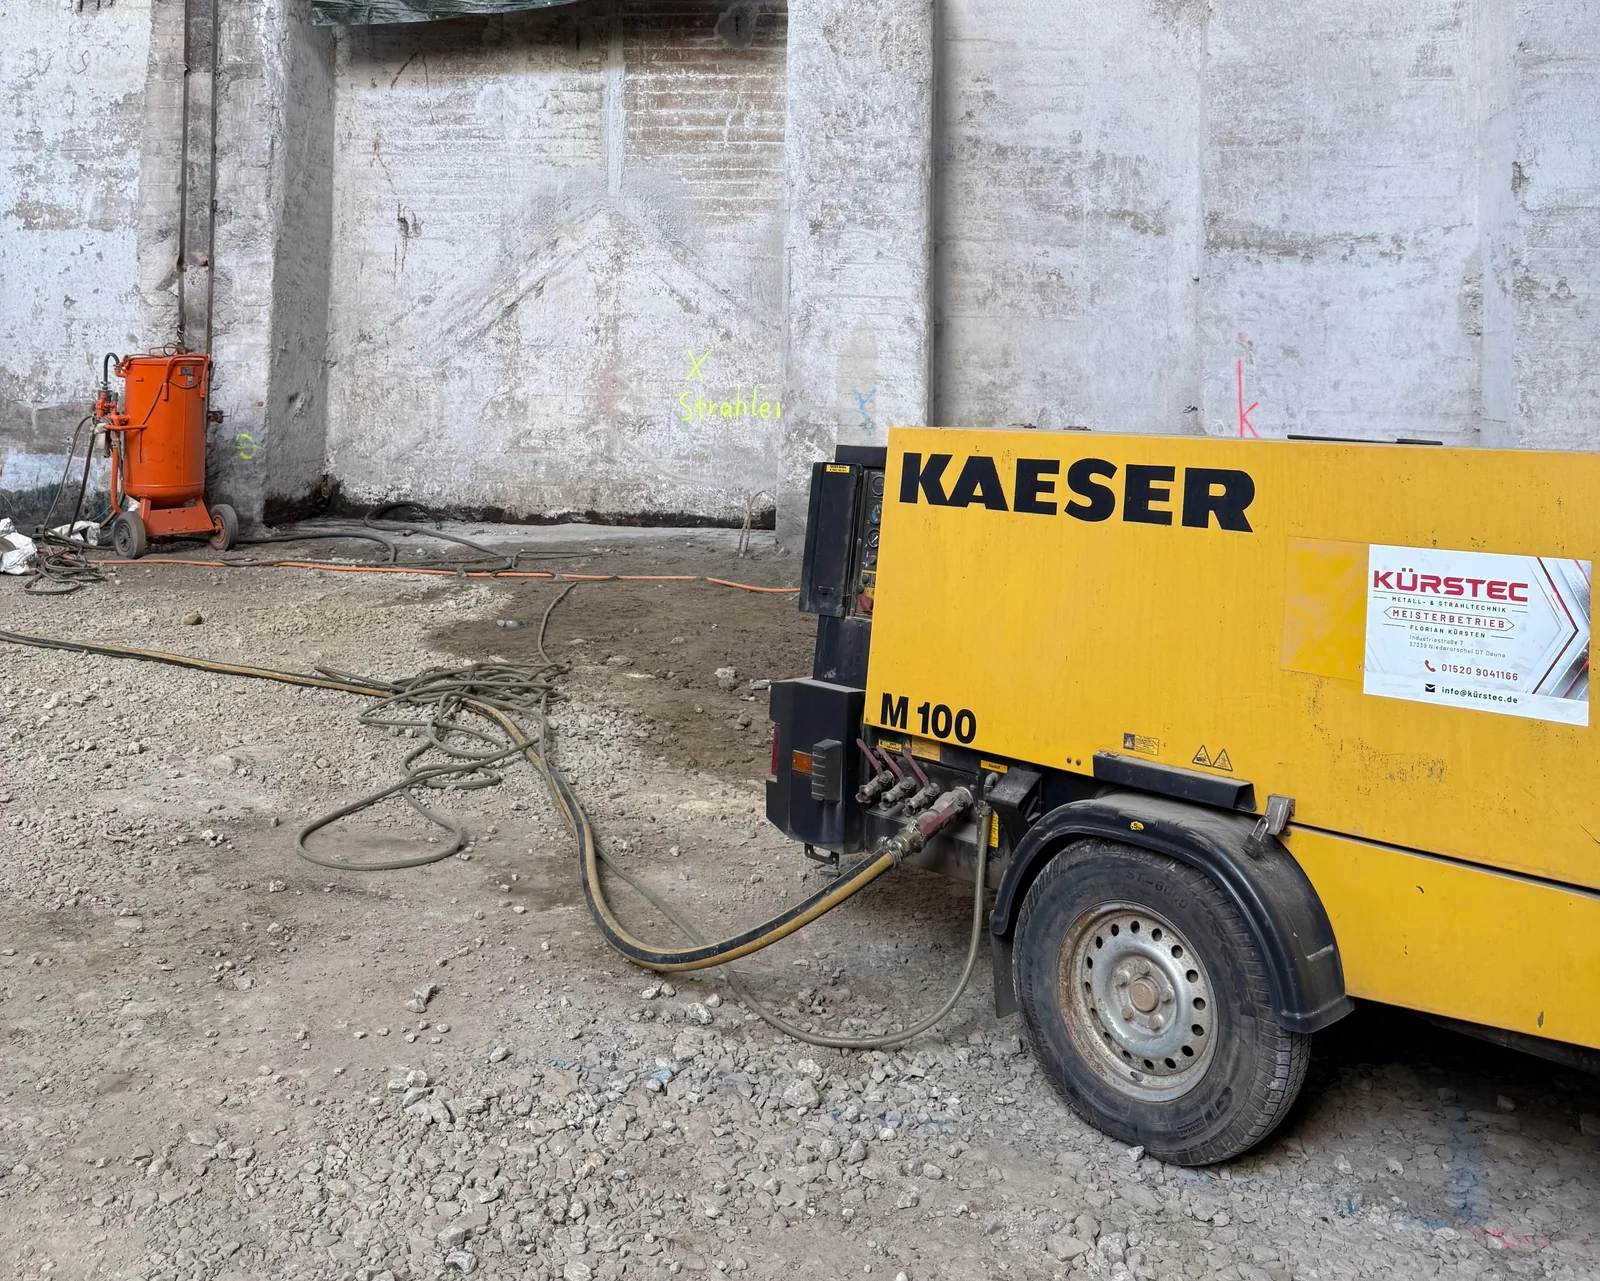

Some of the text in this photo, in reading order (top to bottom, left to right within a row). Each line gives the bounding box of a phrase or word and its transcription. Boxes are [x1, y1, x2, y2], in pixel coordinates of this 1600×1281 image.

[899, 451, 1256, 533] KAESER
[1373, 567, 1529, 603] KÜRSTEC
[1391, 596, 1426, 606] METALL-
[1438, 601, 1507, 613] STRAHLTECHNIK
[1392, 609, 1506, 629] MEISTERBETRIEB
[1409, 624, 1486, 638] FLORIAN KÜRSTEN
[1441, 663, 1519, 681] 01520 9041166
[1441, 686, 1518, 704] info@kürstec.de
[880, 692, 977, 744] M 100
